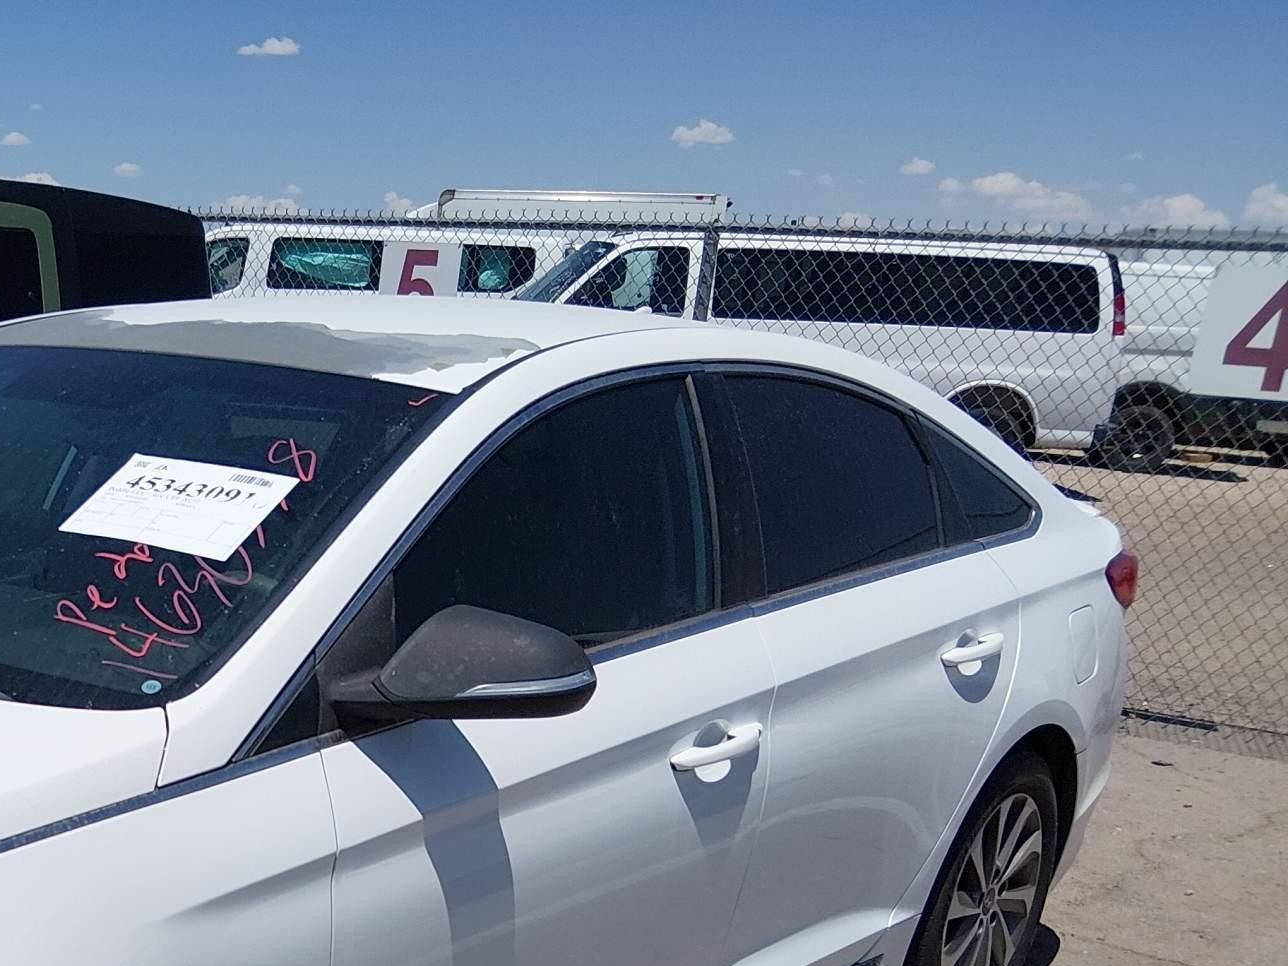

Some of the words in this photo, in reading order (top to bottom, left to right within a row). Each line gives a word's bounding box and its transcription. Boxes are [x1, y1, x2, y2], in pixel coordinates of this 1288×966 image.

[397, 248, 439, 297] 5
[1222, 279, 1288, 393] 4
[126, 474, 257, 504] 45343091
